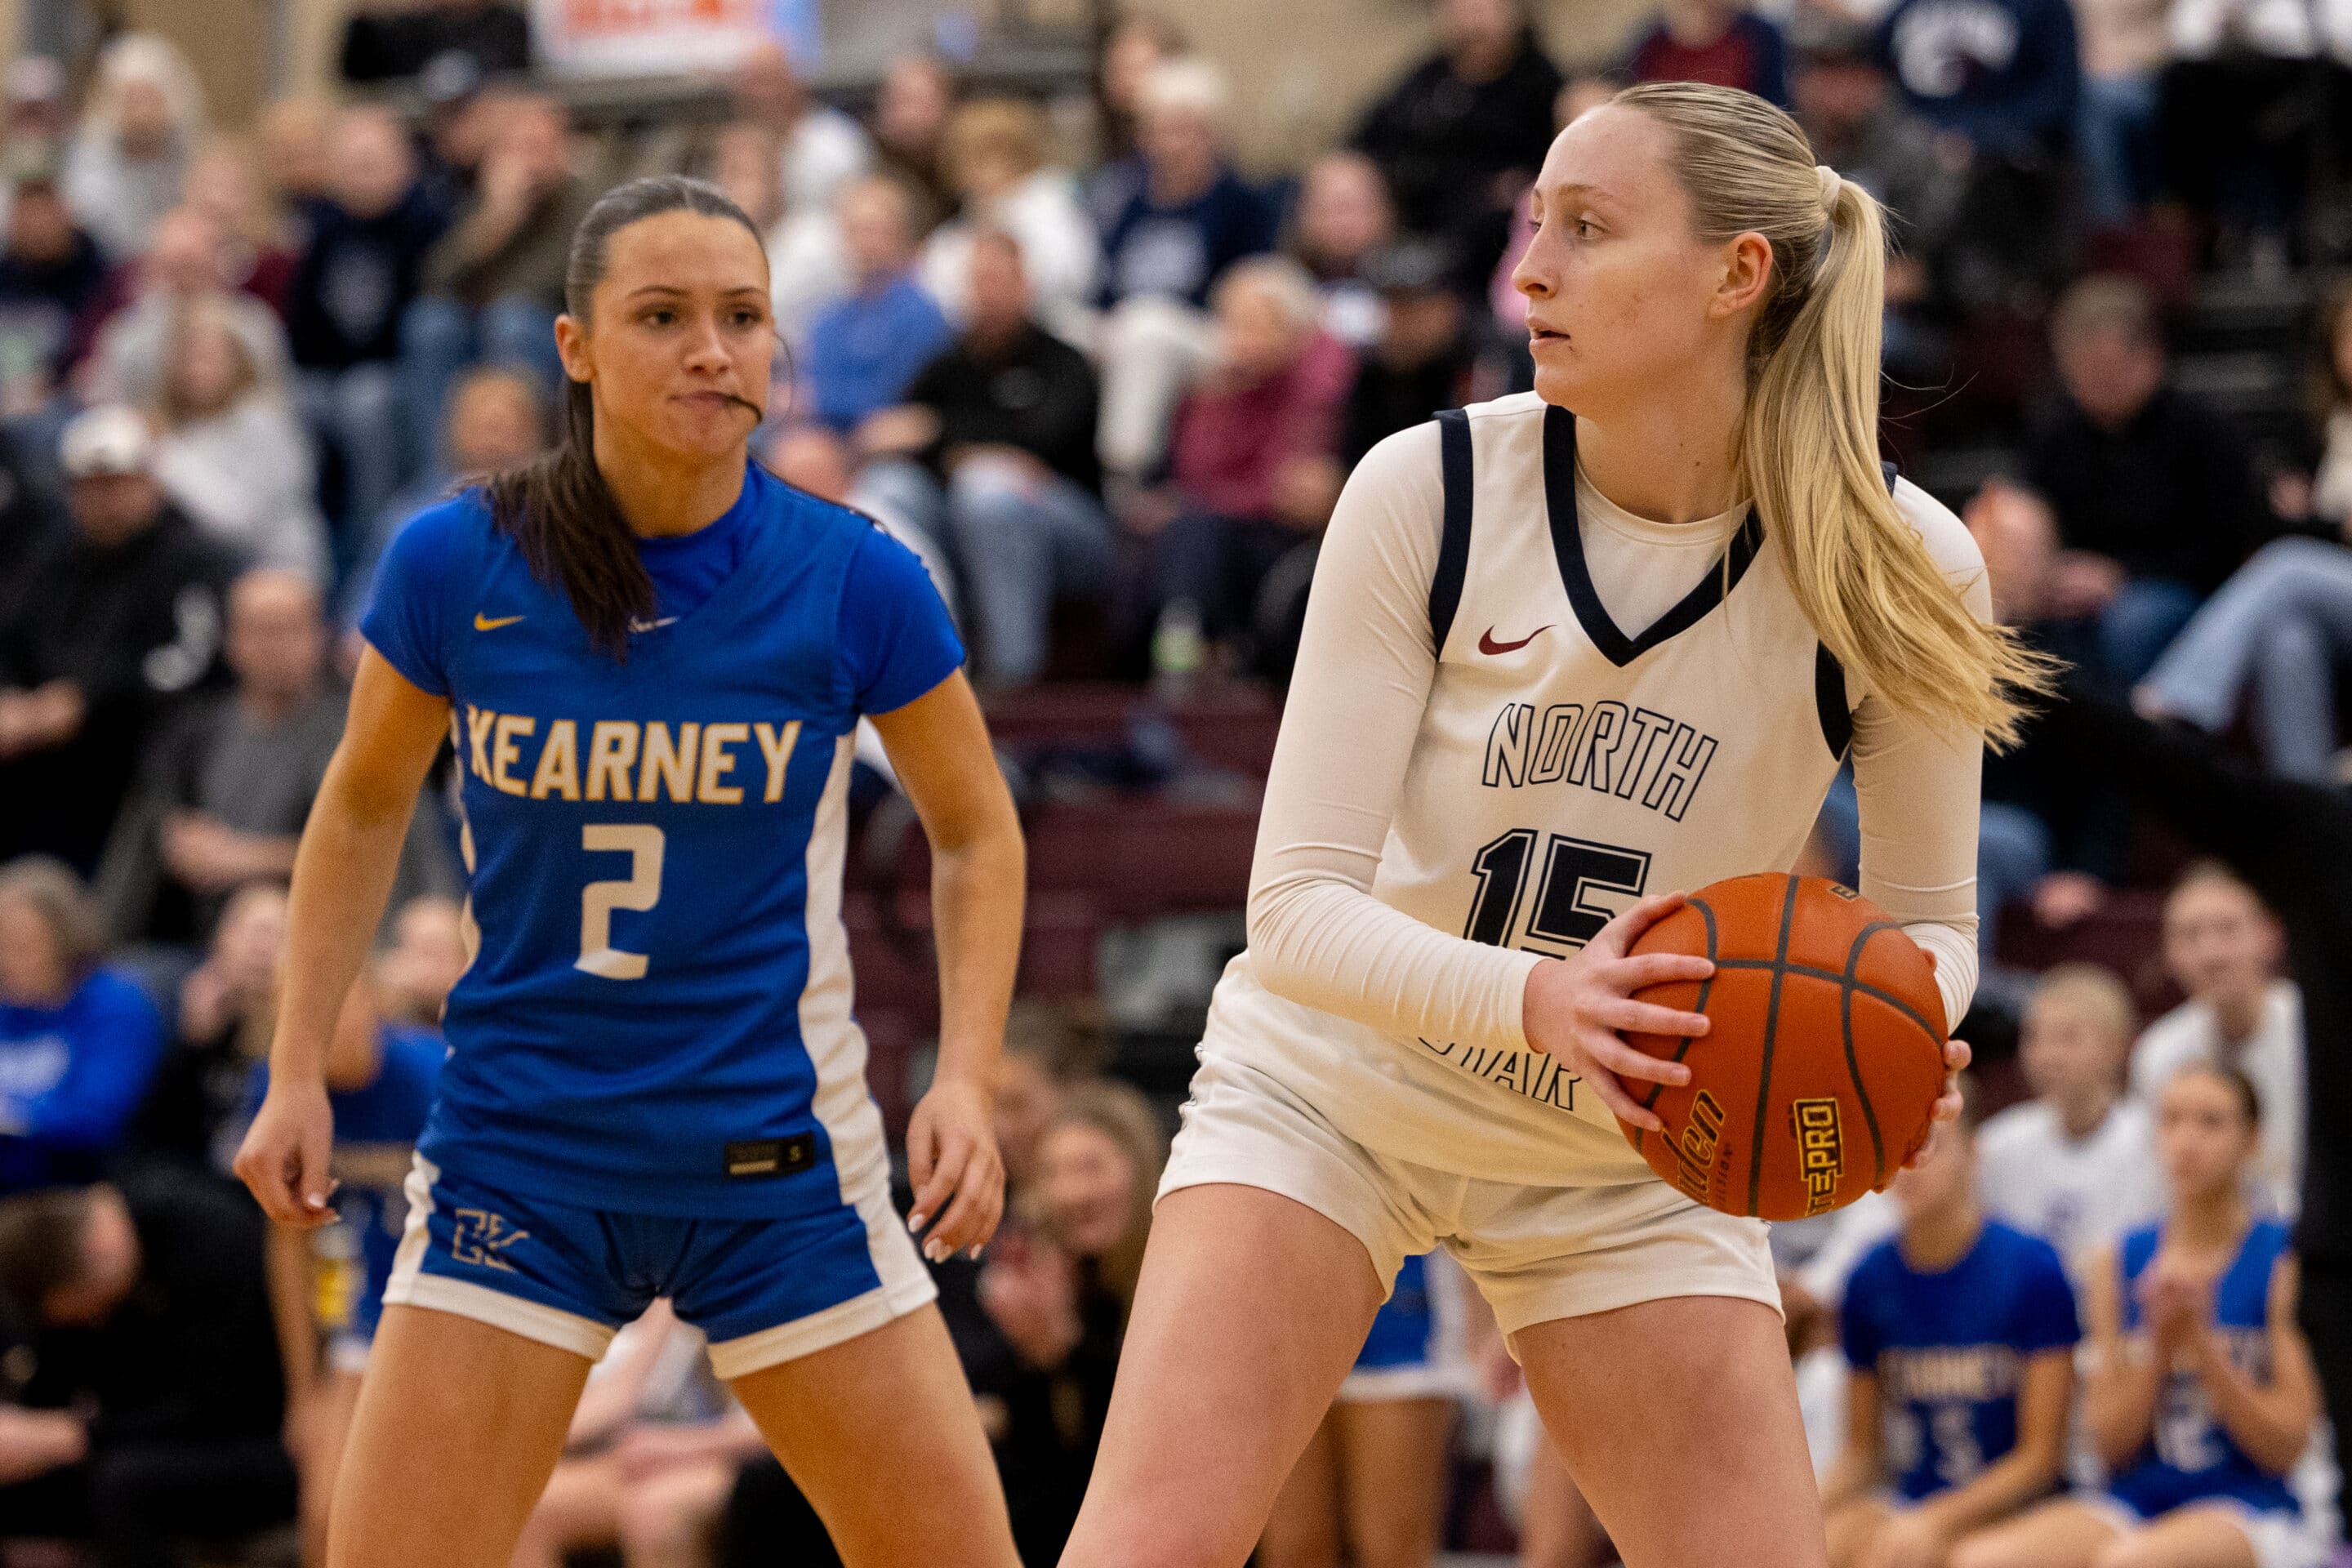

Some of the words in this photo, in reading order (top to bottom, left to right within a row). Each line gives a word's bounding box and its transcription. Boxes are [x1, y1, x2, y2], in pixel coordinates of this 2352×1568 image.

[466, 704, 803, 804] KEARNEY
[1482, 701, 1719, 822] NORTH
[573, 823, 666, 980] 2
[1463, 828, 1652, 960] 15
[1418, 1036, 1582, 1111] AR
